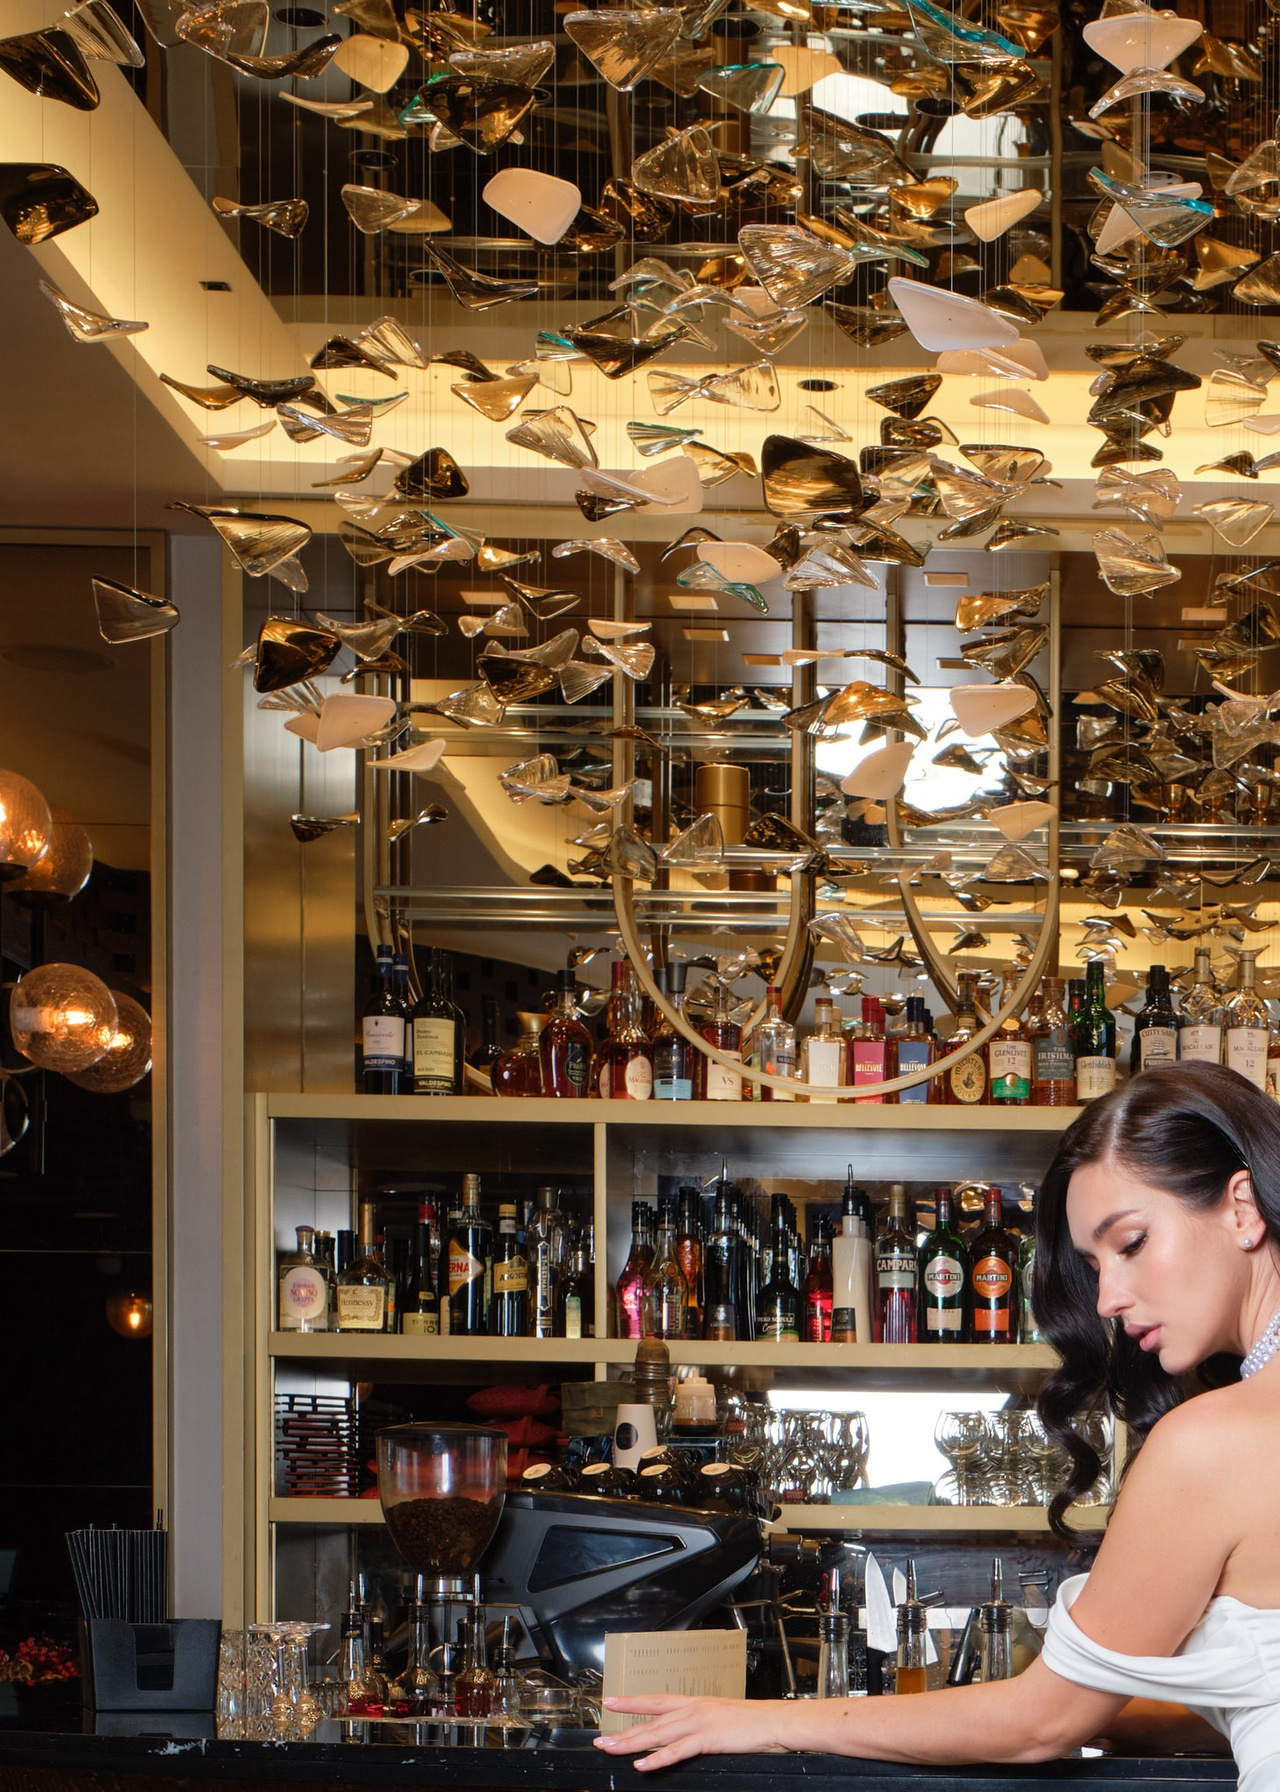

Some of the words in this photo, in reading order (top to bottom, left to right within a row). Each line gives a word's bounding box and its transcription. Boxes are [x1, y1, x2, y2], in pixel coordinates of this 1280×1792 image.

[1141, 1029, 1161, 1038] CUTTY
[994, 1049, 1028, 1058] GLENLIVET
[1007, 1057, 1016, 1065] 12
[1080, 1060, 1112, 1069] Glenfiddich
[1245, 1059, 1255, 1068] 12
[449, 1262, 470, 1273] ERNA
[876, 1258, 917, 1272] CAMPARI
[927, 1273, 961, 1282] MARTINI
[976, 1273, 1009, 1282] MARTINI
[340, 1299, 374, 1307] Hennessy
